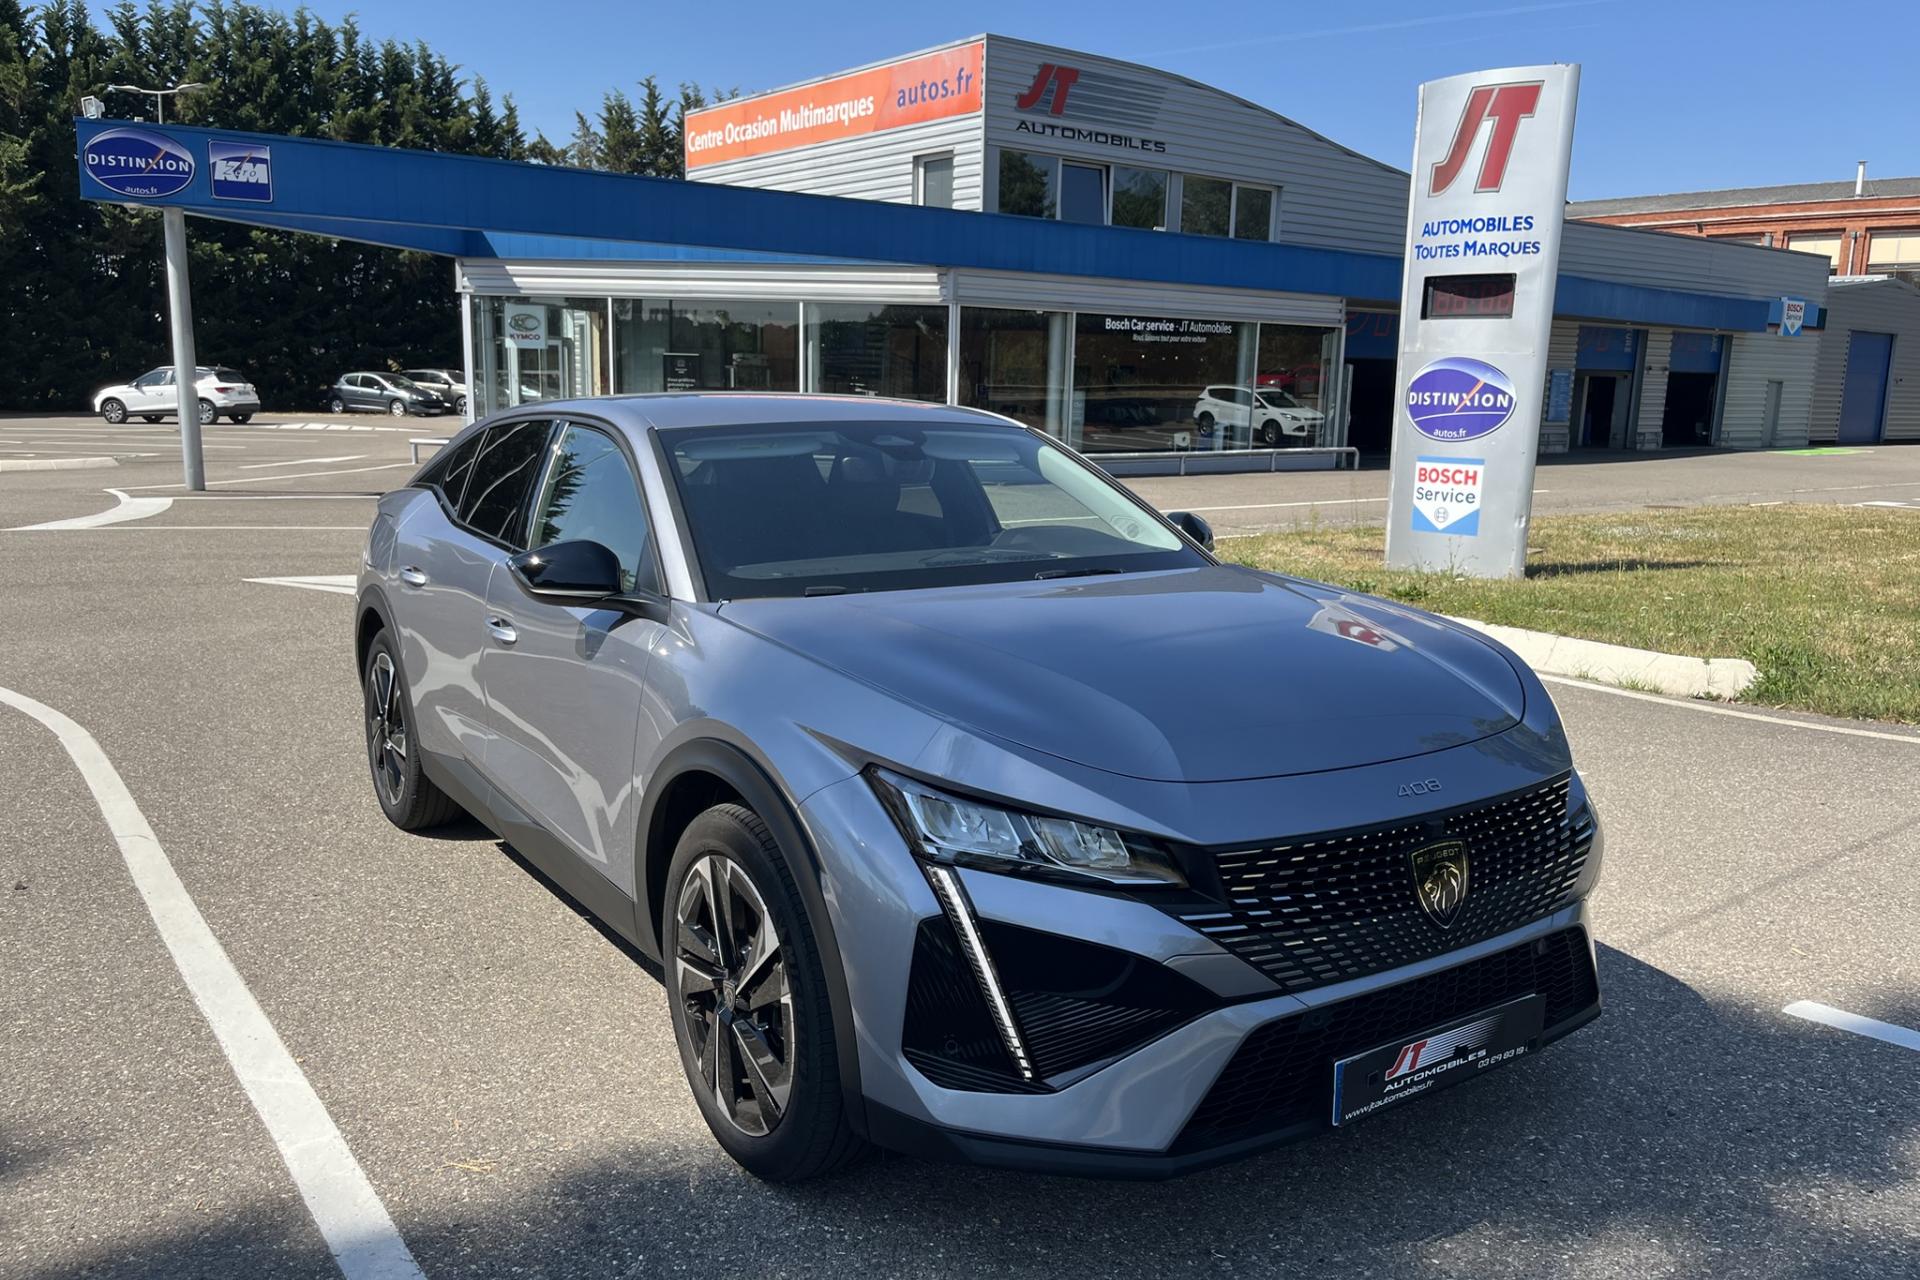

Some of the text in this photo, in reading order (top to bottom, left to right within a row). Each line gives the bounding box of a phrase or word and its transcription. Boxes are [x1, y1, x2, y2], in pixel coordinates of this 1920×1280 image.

[897, 67, 973, 107] autos.fr
[1016, 63, 1080, 117] JT
[688, 96, 874, 152] Centre Occasion Multimarques
[1016, 120, 1166, 153] AUTOMOBILES
[1428, 80, 1545, 198] JT
[88, 152, 190, 173] DISTINXION
[124, 185, 158, 195] autos.fr
[1422, 216, 1534, 237] AUTOMOBILES
[1415, 240, 1541, 260] TOUTES MARQUES
[1105, 318, 1130, 330] Bosch
[1131, 319, 1145, 331] Car
[1146, 319, 1175, 331] service
[1180, 321, 1189, 332] JT
[1189, 321, 1232, 334] Automobiles
[1409, 391, 1509, 408] DISTINXION
[1433, 428, 1467, 438] autos.fr
[1418, 467, 1477, 486] BOSCH
[1416, 486, 1476, 504] Service
[1398, 778, 1442, 797] 408
[1383, 1049, 1487, 1093] AUTOMOBILES
[1385, 1040, 1428, 1081] JT
